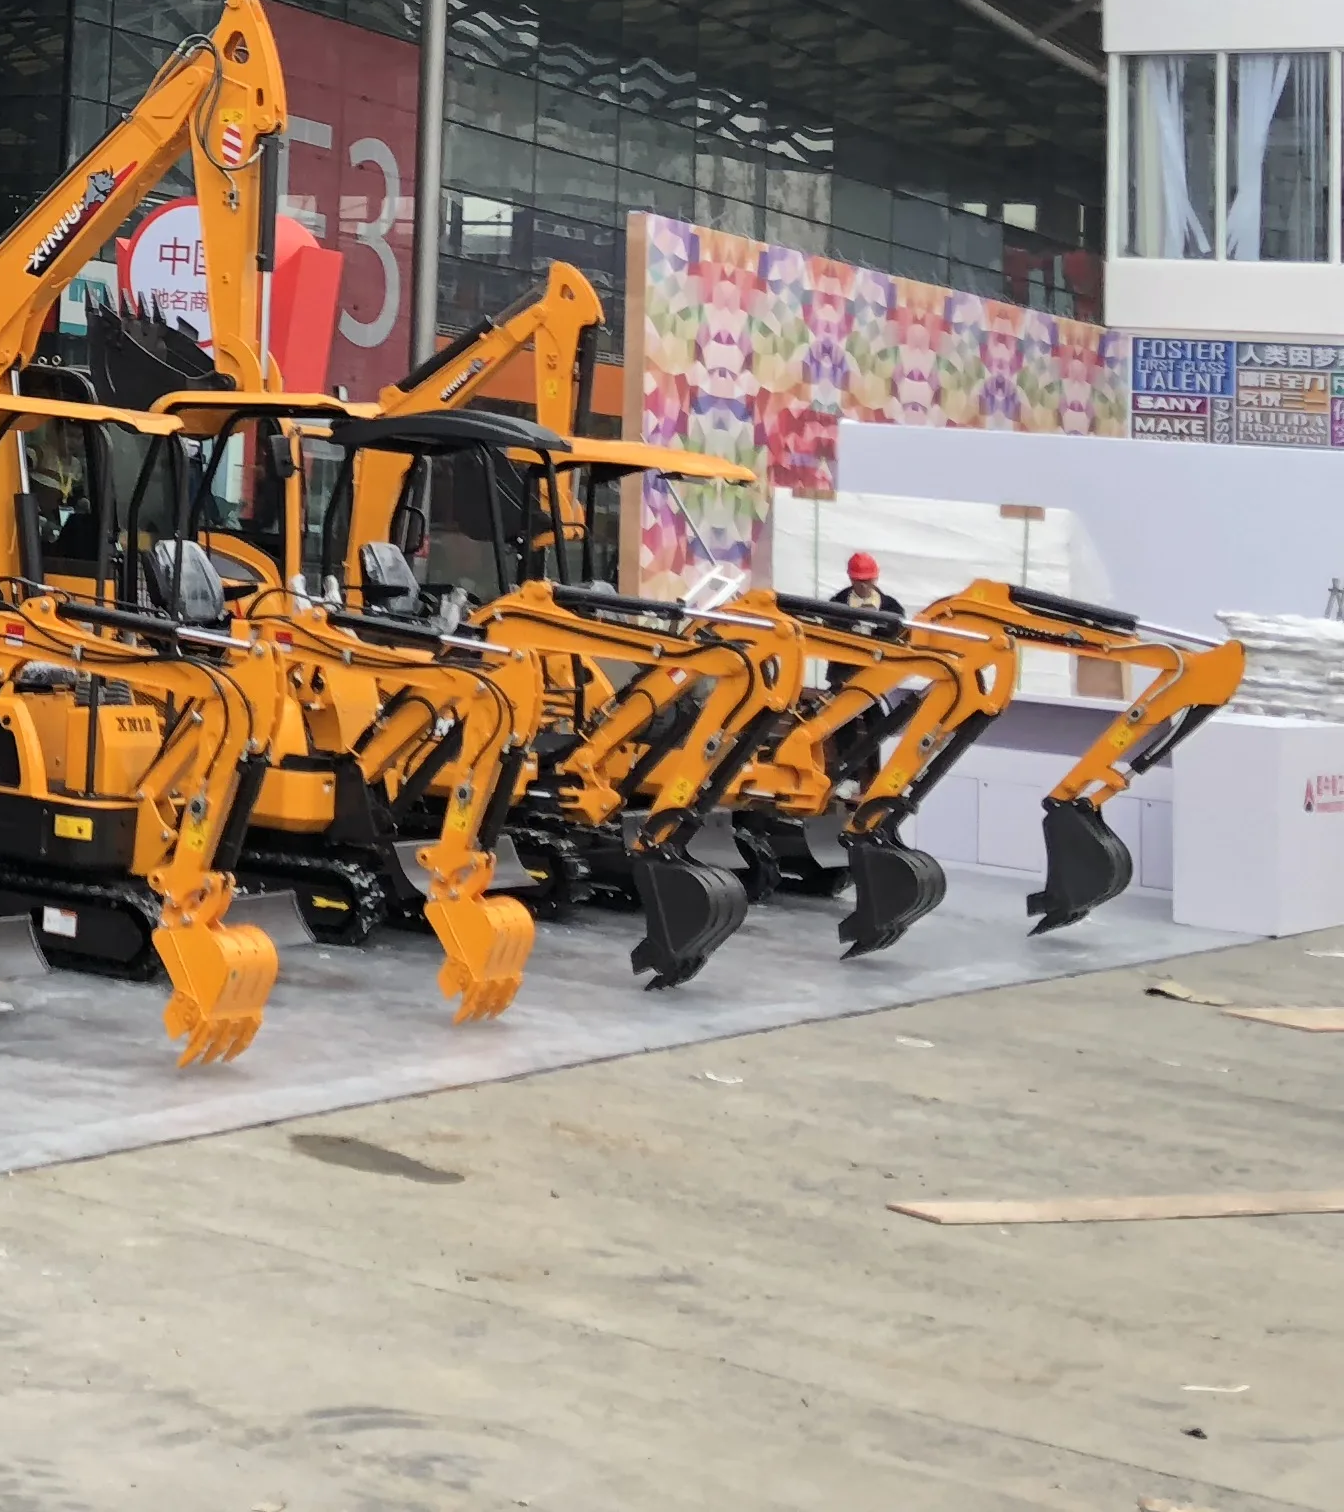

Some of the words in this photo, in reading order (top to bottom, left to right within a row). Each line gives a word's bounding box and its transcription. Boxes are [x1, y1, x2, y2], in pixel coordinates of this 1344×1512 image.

[29, 201, 82, 270] XINIU
[1137, 339, 1226, 361] FOSTER
[1138, 359, 1226, 374] FIRST-CLASS
[1137, 370, 1226, 393] TALENT
[1136, 395, 1203, 411] SANY
[1135, 416, 1205, 435] MAKE
[1213, 399, 1230, 444] PASS
